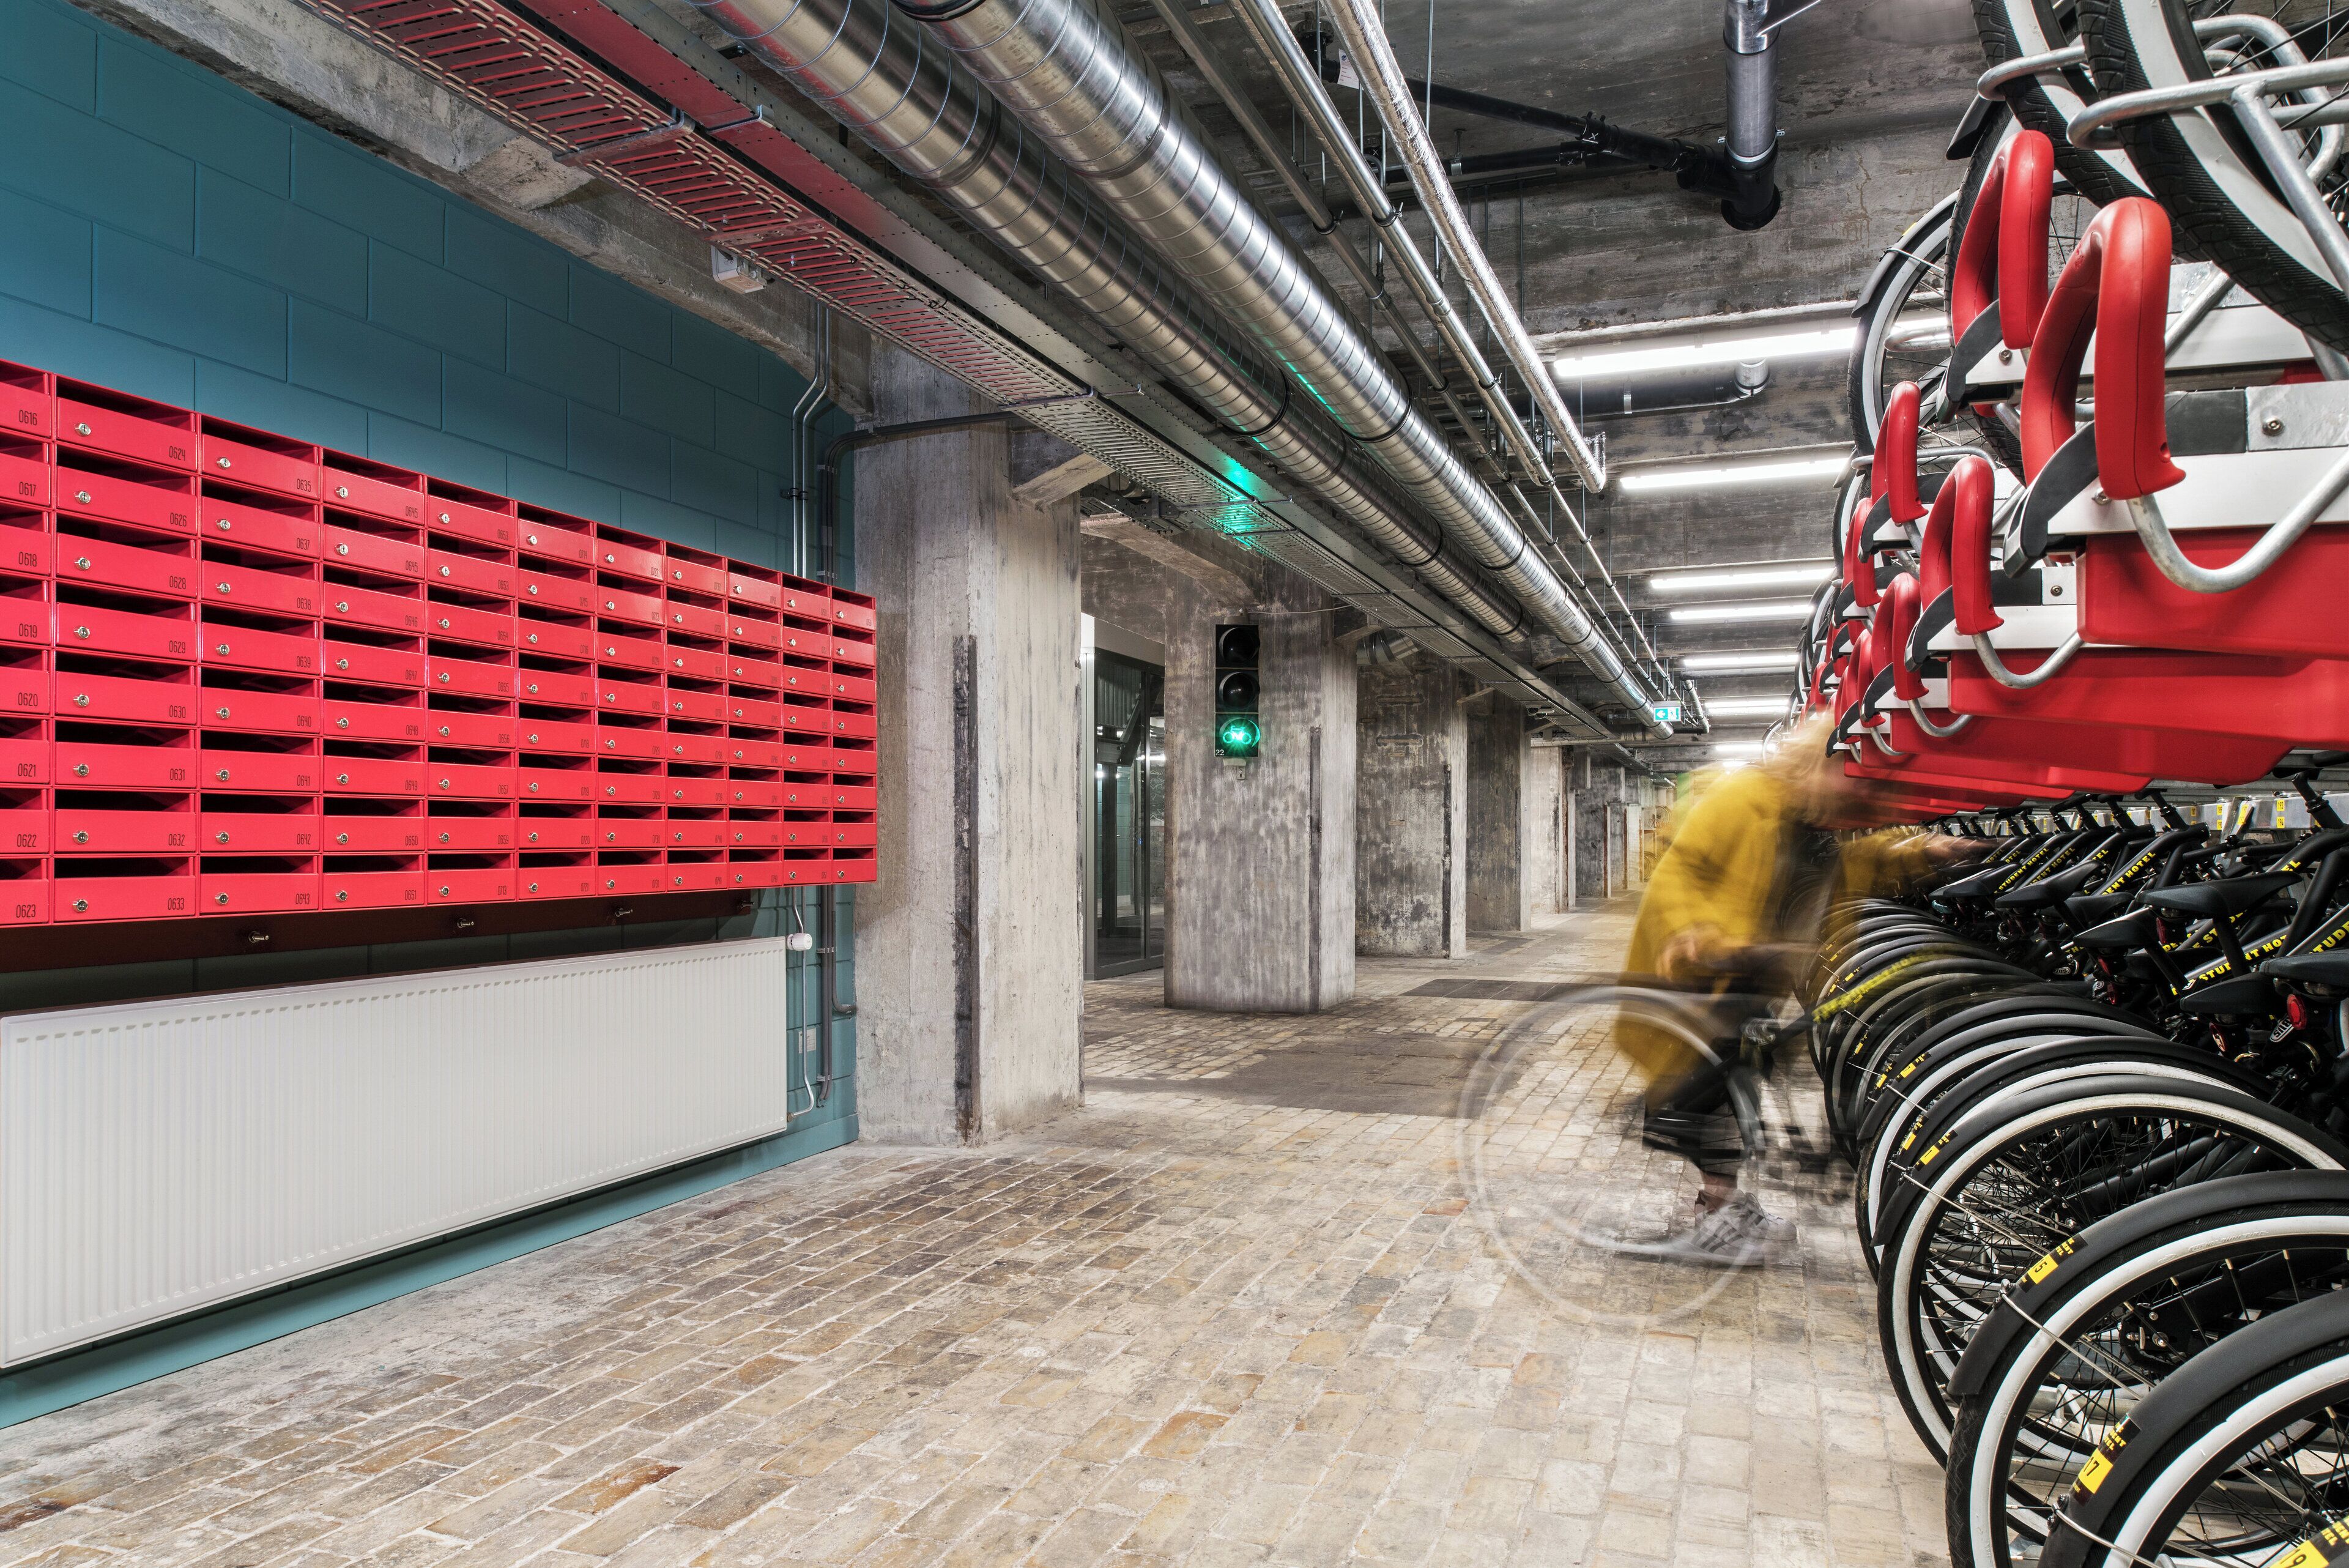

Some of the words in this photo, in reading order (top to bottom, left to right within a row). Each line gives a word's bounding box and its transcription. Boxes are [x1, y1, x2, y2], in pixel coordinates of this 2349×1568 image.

[19, 409, 37, 426] 0616
[169, 445, 185, 461] 0624
[19, 481, 36, 496] 0617
[297, 478, 311, 492] 0635
[406, 506, 418, 519] 0645
[170, 512, 187, 527] 0626
[497, 529, 509, 541] 0653
[297, 538, 310, 550] 0637
[18, 551, 37, 567] 0618
[406, 560, 418, 573] 0645
[169, 576, 186, 590] 0628
[498, 579, 509, 591] 0653
[297, 597, 311, 610] 0638
[405, 615, 418, 627] 0646
[19, 623, 37, 638] 0619
[497, 630, 509, 642] 0654
[169, 640, 186, 654] 0629
[297, 656, 311, 668] 0639
[406, 669, 417, 680] 0647
[497, 682, 509, 693] 0655
[18, 692, 38, 707] 0620
[169, 705, 186, 718] 0630
[297, 715, 311, 727] 0640
[406, 725, 418, 736] 0648
[499, 734, 510, 743] 0656
[18, 764, 36, 777] 0621
[170, 768, 185, 781] 0631
[297, 775, 310, 786] 0641
[405, 780, 418, 790] 0649
[498, 784, 508, 795] 0657
[17, 834, 37, 847] 0622
[168, 833, 185, 846] 0632
[297, 834, 311, 845] 0642
[405, 836, 418, 845] 0650
[498, 835, 509, 844] 0659
[2005, 850, 2021, 863] OTEL
[1998, 865, 2027, 891] STUDENT
[2027, 848, 2049, 866] HOTEL
[2030, 867, 2050, 884] DENT
[2051, 847, 2076, 868] HOTEL
[2101, 877, 2125, 896] DENT
[2124, 852, 2156, 879] HOTEL
[405, 890, 416, 900] 0651
[498, 885, 507, 896] 0713
[168, 897, 184, 910] 0633
[295, 893, 310, 905] 0643
[16, 904, 35, 918] 0623
[2309, 920, 2349, 953] TUDE
[2273, 1016, 2291, 1038] BUS
[2083, 1456, 2100, 1477] 17
